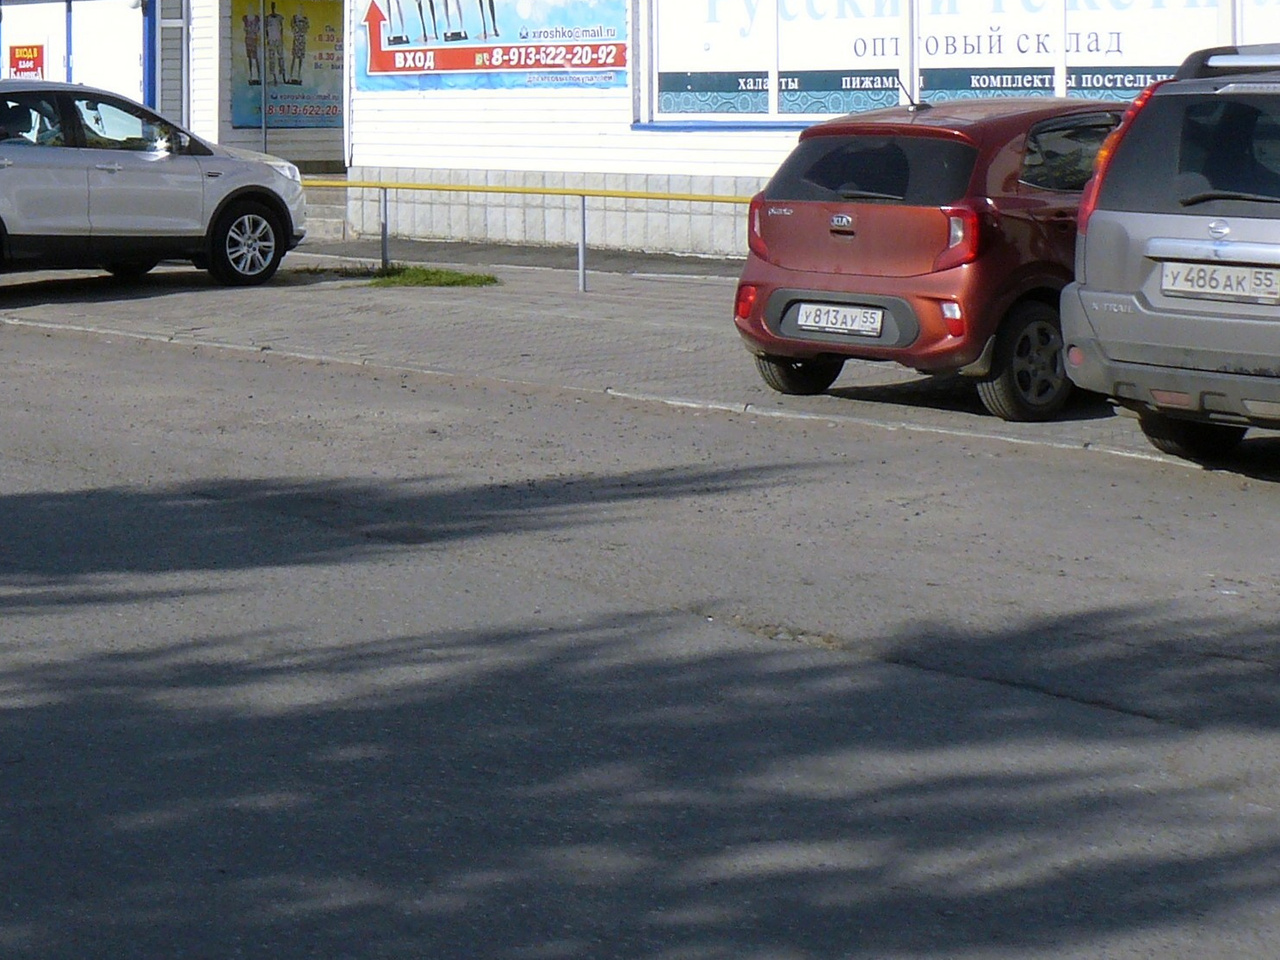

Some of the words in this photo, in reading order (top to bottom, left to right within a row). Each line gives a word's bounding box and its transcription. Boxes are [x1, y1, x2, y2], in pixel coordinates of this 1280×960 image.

[1016, 30, 1123, 56] склад
[395, 51, 435, 70] ВХОД
[738, 76, 798, 90] халаты
[832, 216, 848, 226] KIA
[1170, 266, 1247, 292] У486АК
[1253, 272, 1273, 287] 55
[803, 308, 858, 327] У813АУ
[861, 311, 876, 324] 55
